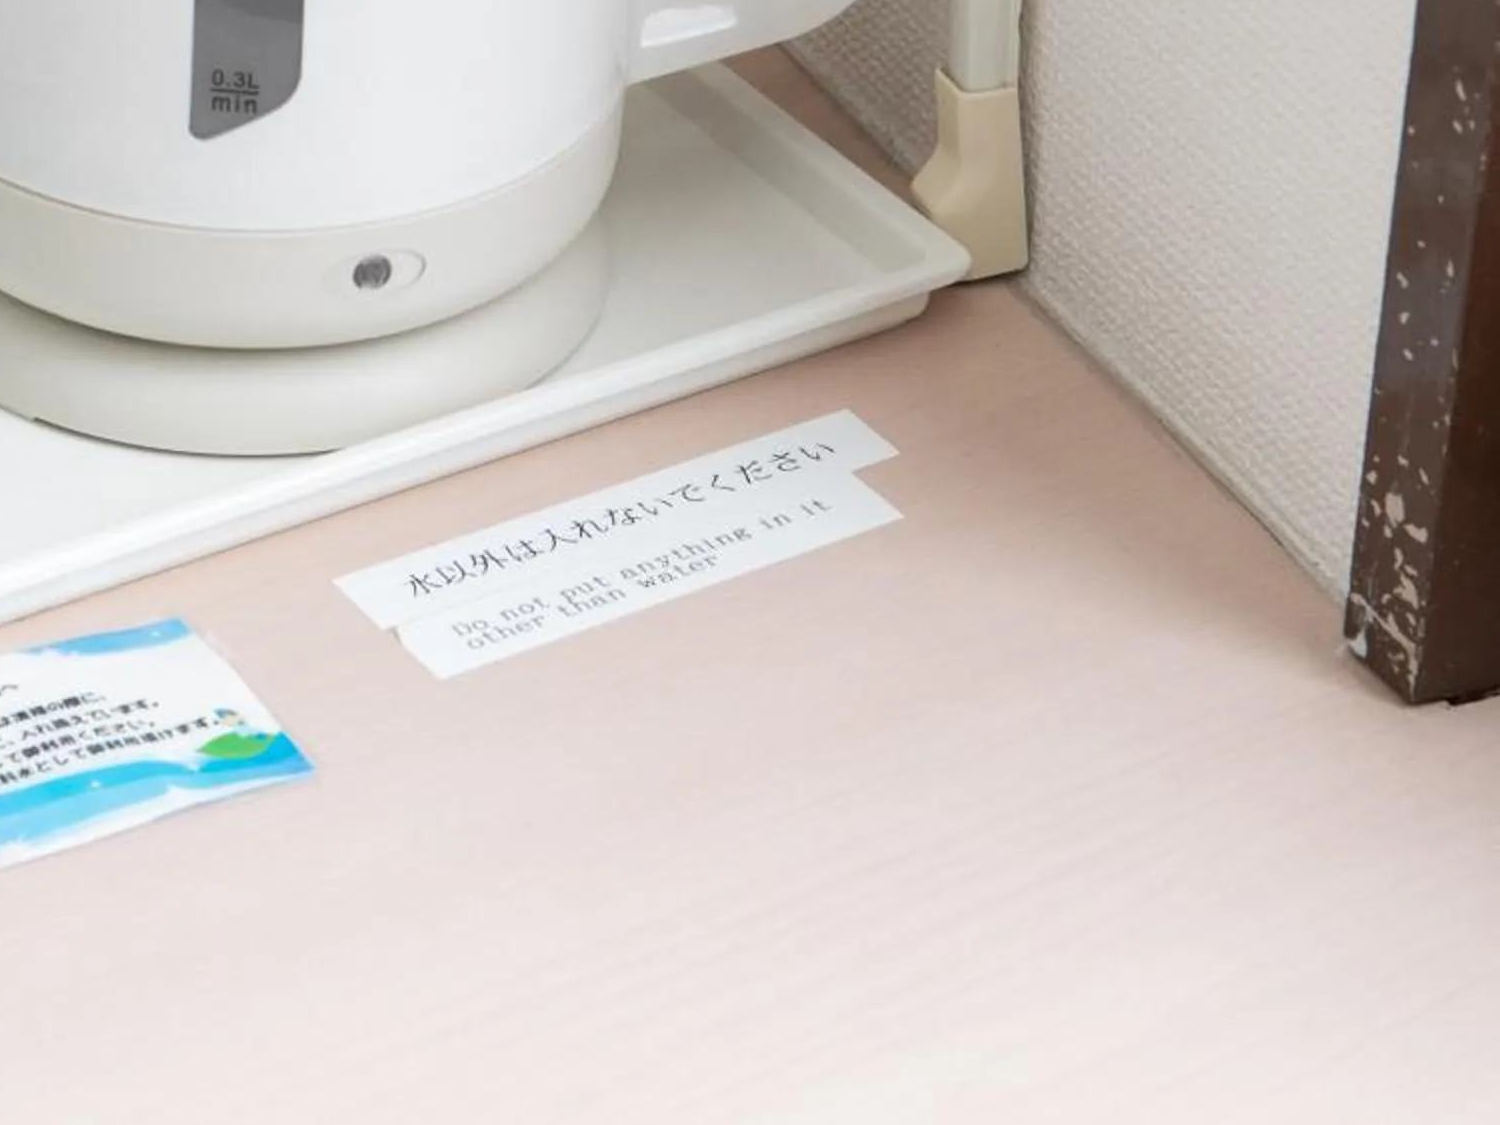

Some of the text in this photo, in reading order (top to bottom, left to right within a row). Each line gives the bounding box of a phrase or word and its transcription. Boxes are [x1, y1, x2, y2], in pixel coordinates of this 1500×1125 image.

[211, 69, 260, 90] 0.3L
[211, 94, 258, 115] min
[404, 443, 836, 598] 水以外は入れないでください
[452, 499, 833, 637] Do not put anything in it
[467, 555, 718, 650] other than water
